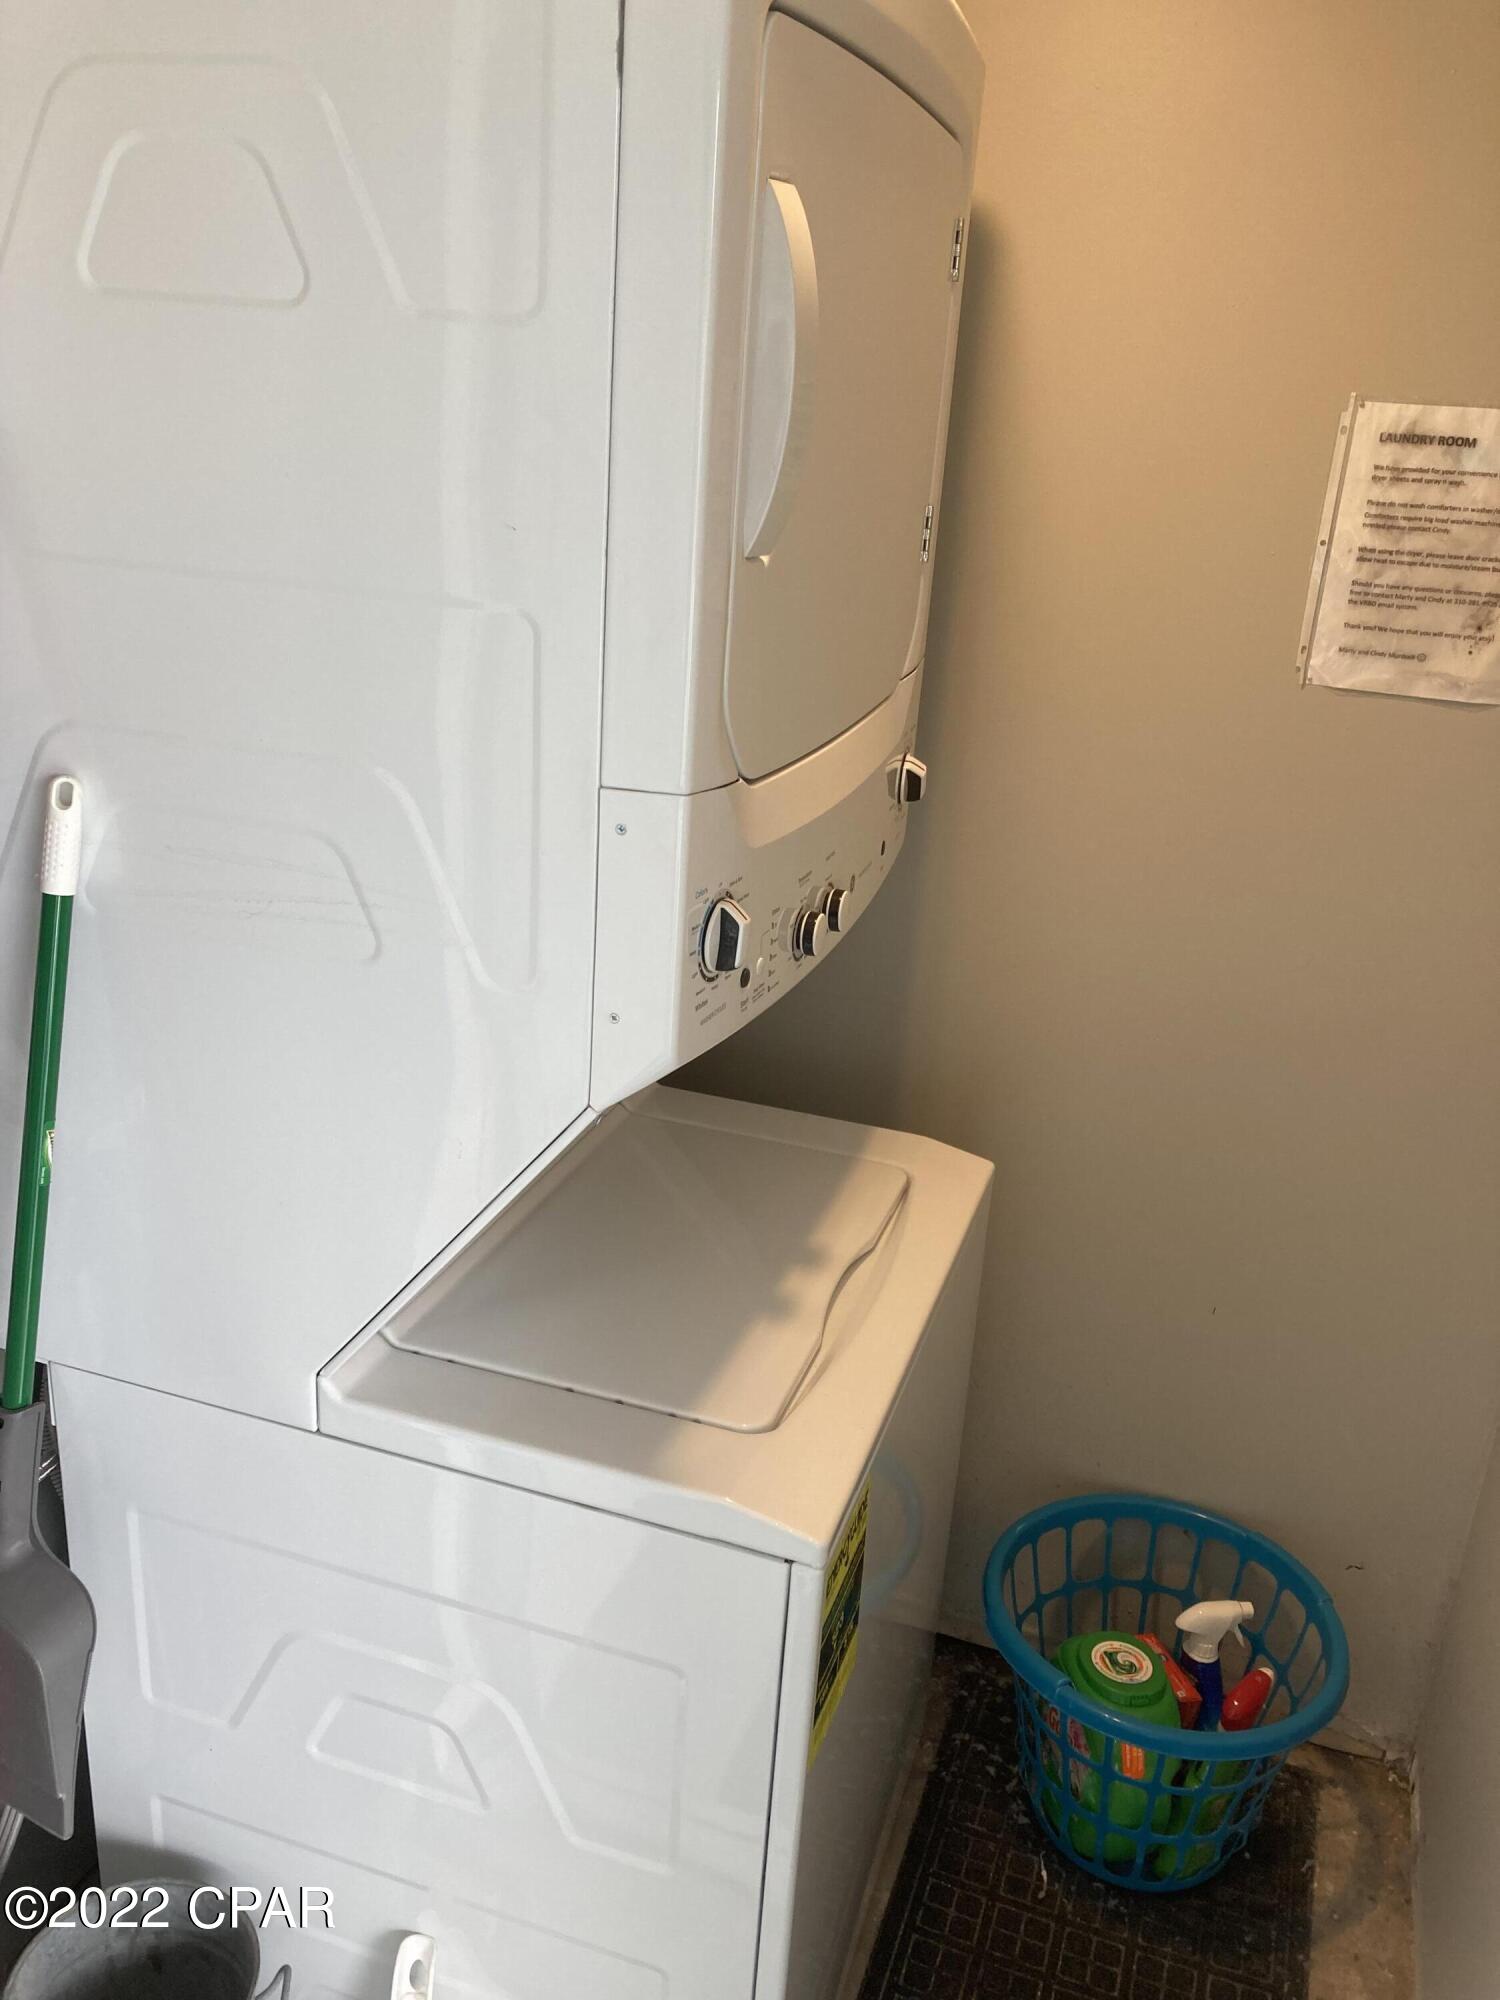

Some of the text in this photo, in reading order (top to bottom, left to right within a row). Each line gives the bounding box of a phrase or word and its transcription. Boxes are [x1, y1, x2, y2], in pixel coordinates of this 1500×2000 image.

[1379, 431, 1478, 449] LAUNDRY ROOM
[1441, 469, 1456, 477] your
[1423, 516, 1433, 524] big
[1425, 551, 1446, 560] please
[1427, 596, 1444, 604] Cindy
[1344, 622, 1361, 630] Thank
